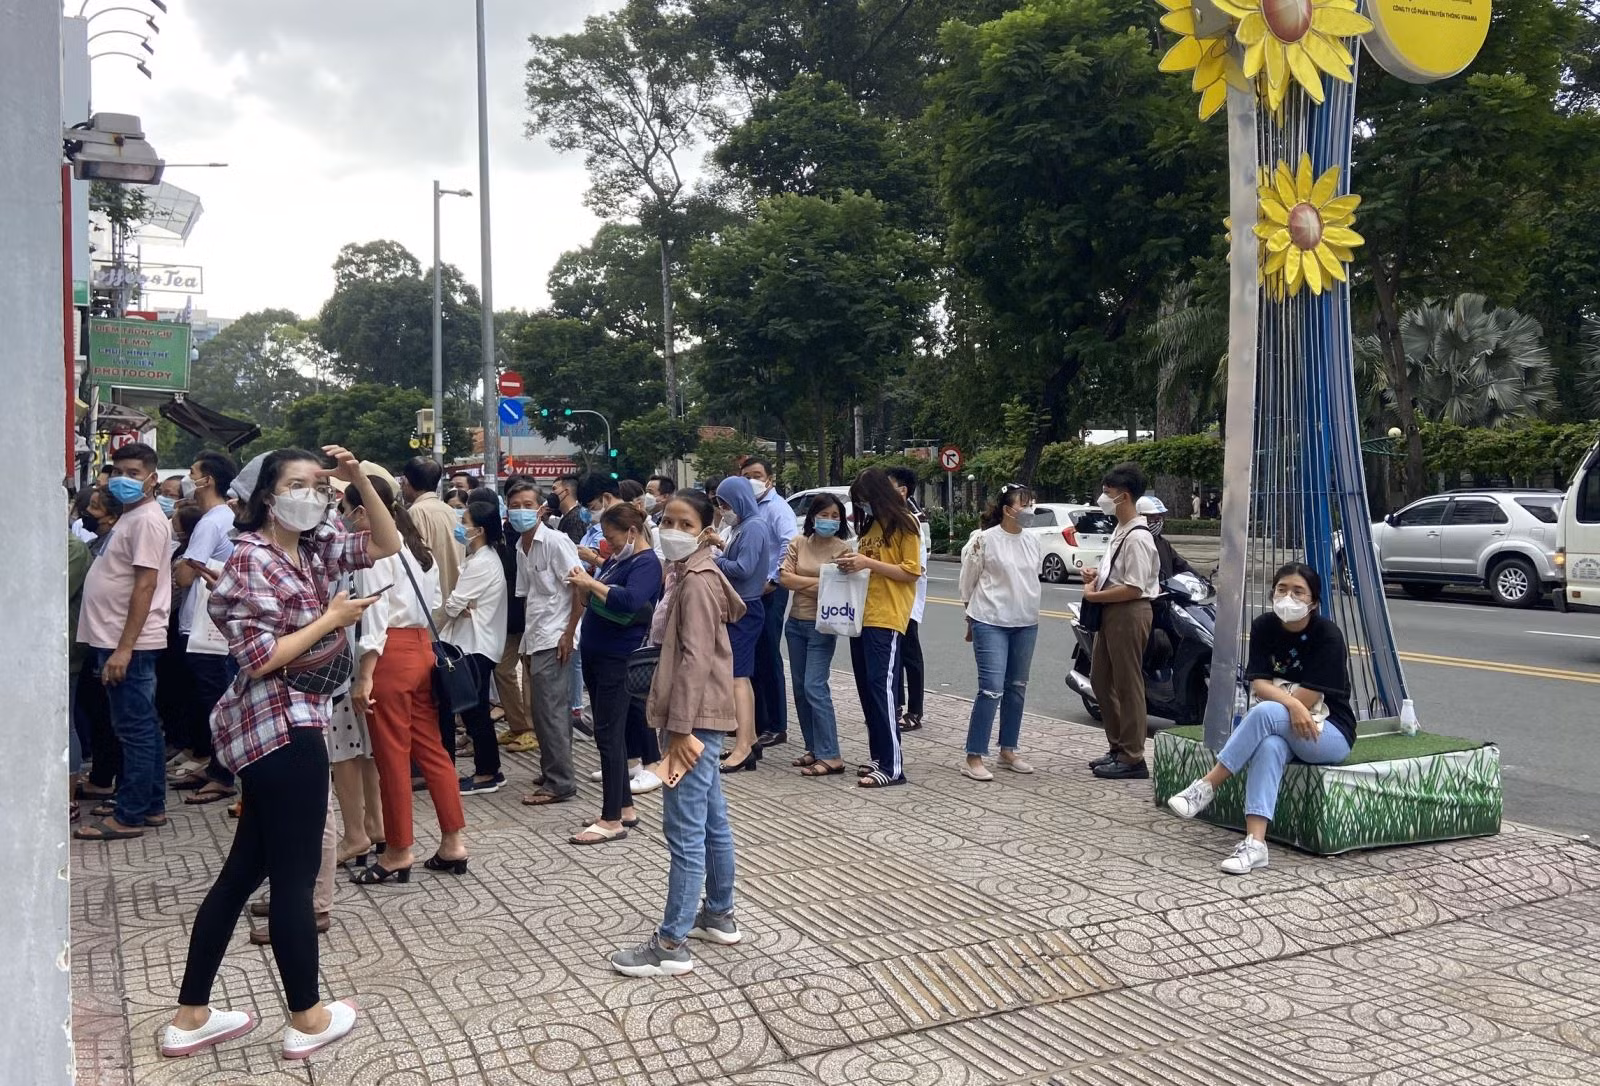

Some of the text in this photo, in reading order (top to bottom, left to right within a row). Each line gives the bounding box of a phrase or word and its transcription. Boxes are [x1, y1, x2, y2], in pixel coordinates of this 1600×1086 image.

[163, 269, 198, 288] Tea
[94, 367, 172, 380] PHOTOCOPY
[821, 602, 855, 621] yody
